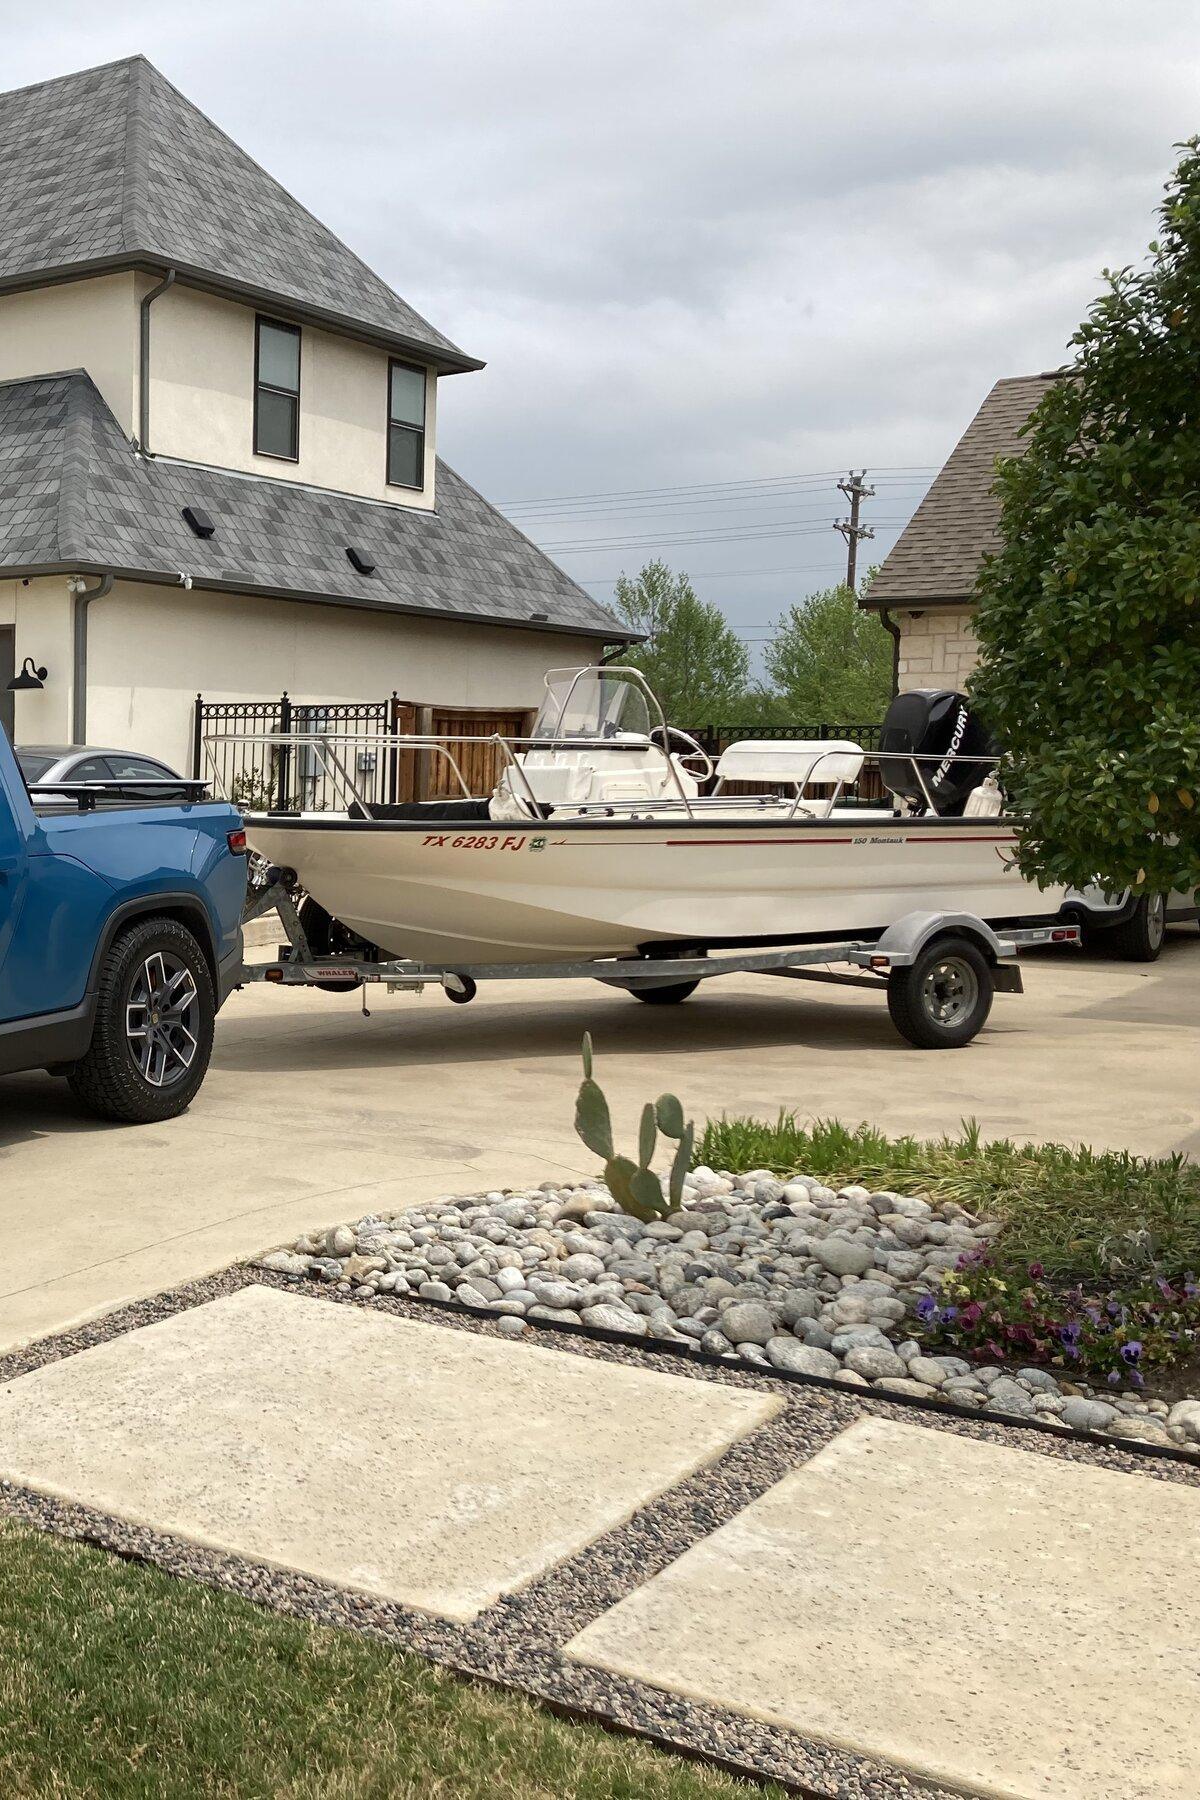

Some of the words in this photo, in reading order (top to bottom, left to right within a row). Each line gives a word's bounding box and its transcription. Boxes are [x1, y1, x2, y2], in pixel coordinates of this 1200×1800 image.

[931, 704, 968, 787] MERCURY
[422, 835, 450, 847] TX
[451, 836, 499, 850] 6283
[500, 836, 526, 851] FJ
